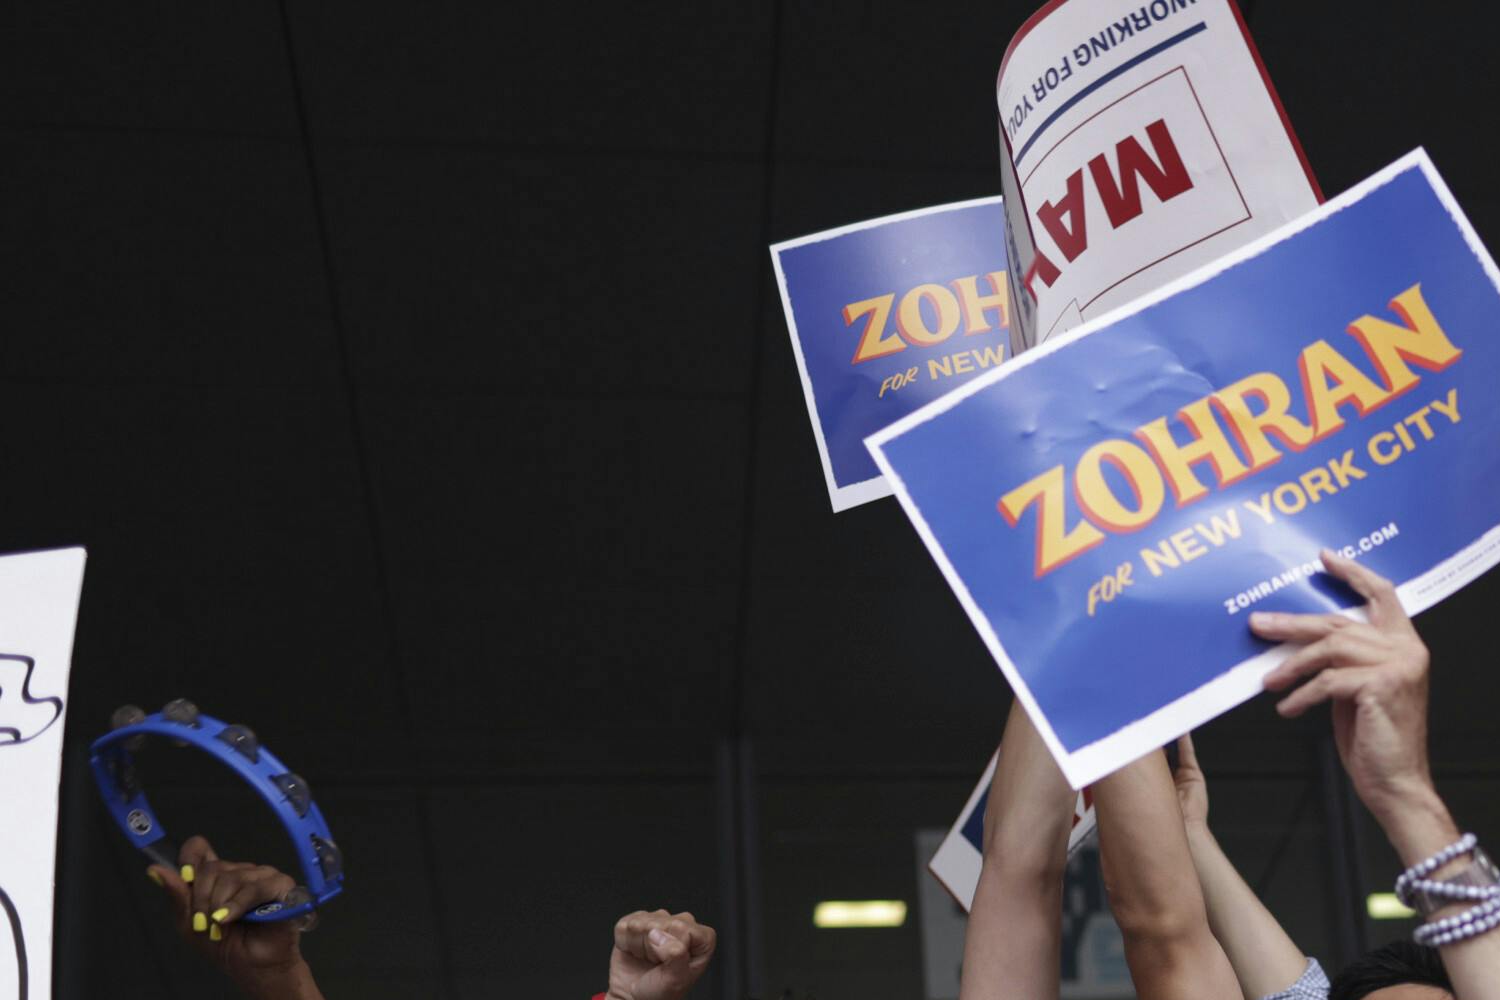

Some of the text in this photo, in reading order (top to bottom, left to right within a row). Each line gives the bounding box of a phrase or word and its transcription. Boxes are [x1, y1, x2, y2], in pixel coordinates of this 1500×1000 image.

[1031, 56, 1073, 103] FOR
[879, 344, 1004, 398] FOR NEW
[996, 282, 1464, 580] ZOHRAN
[1087, 388, 1463, 617] FOR NEW YORK CITY
